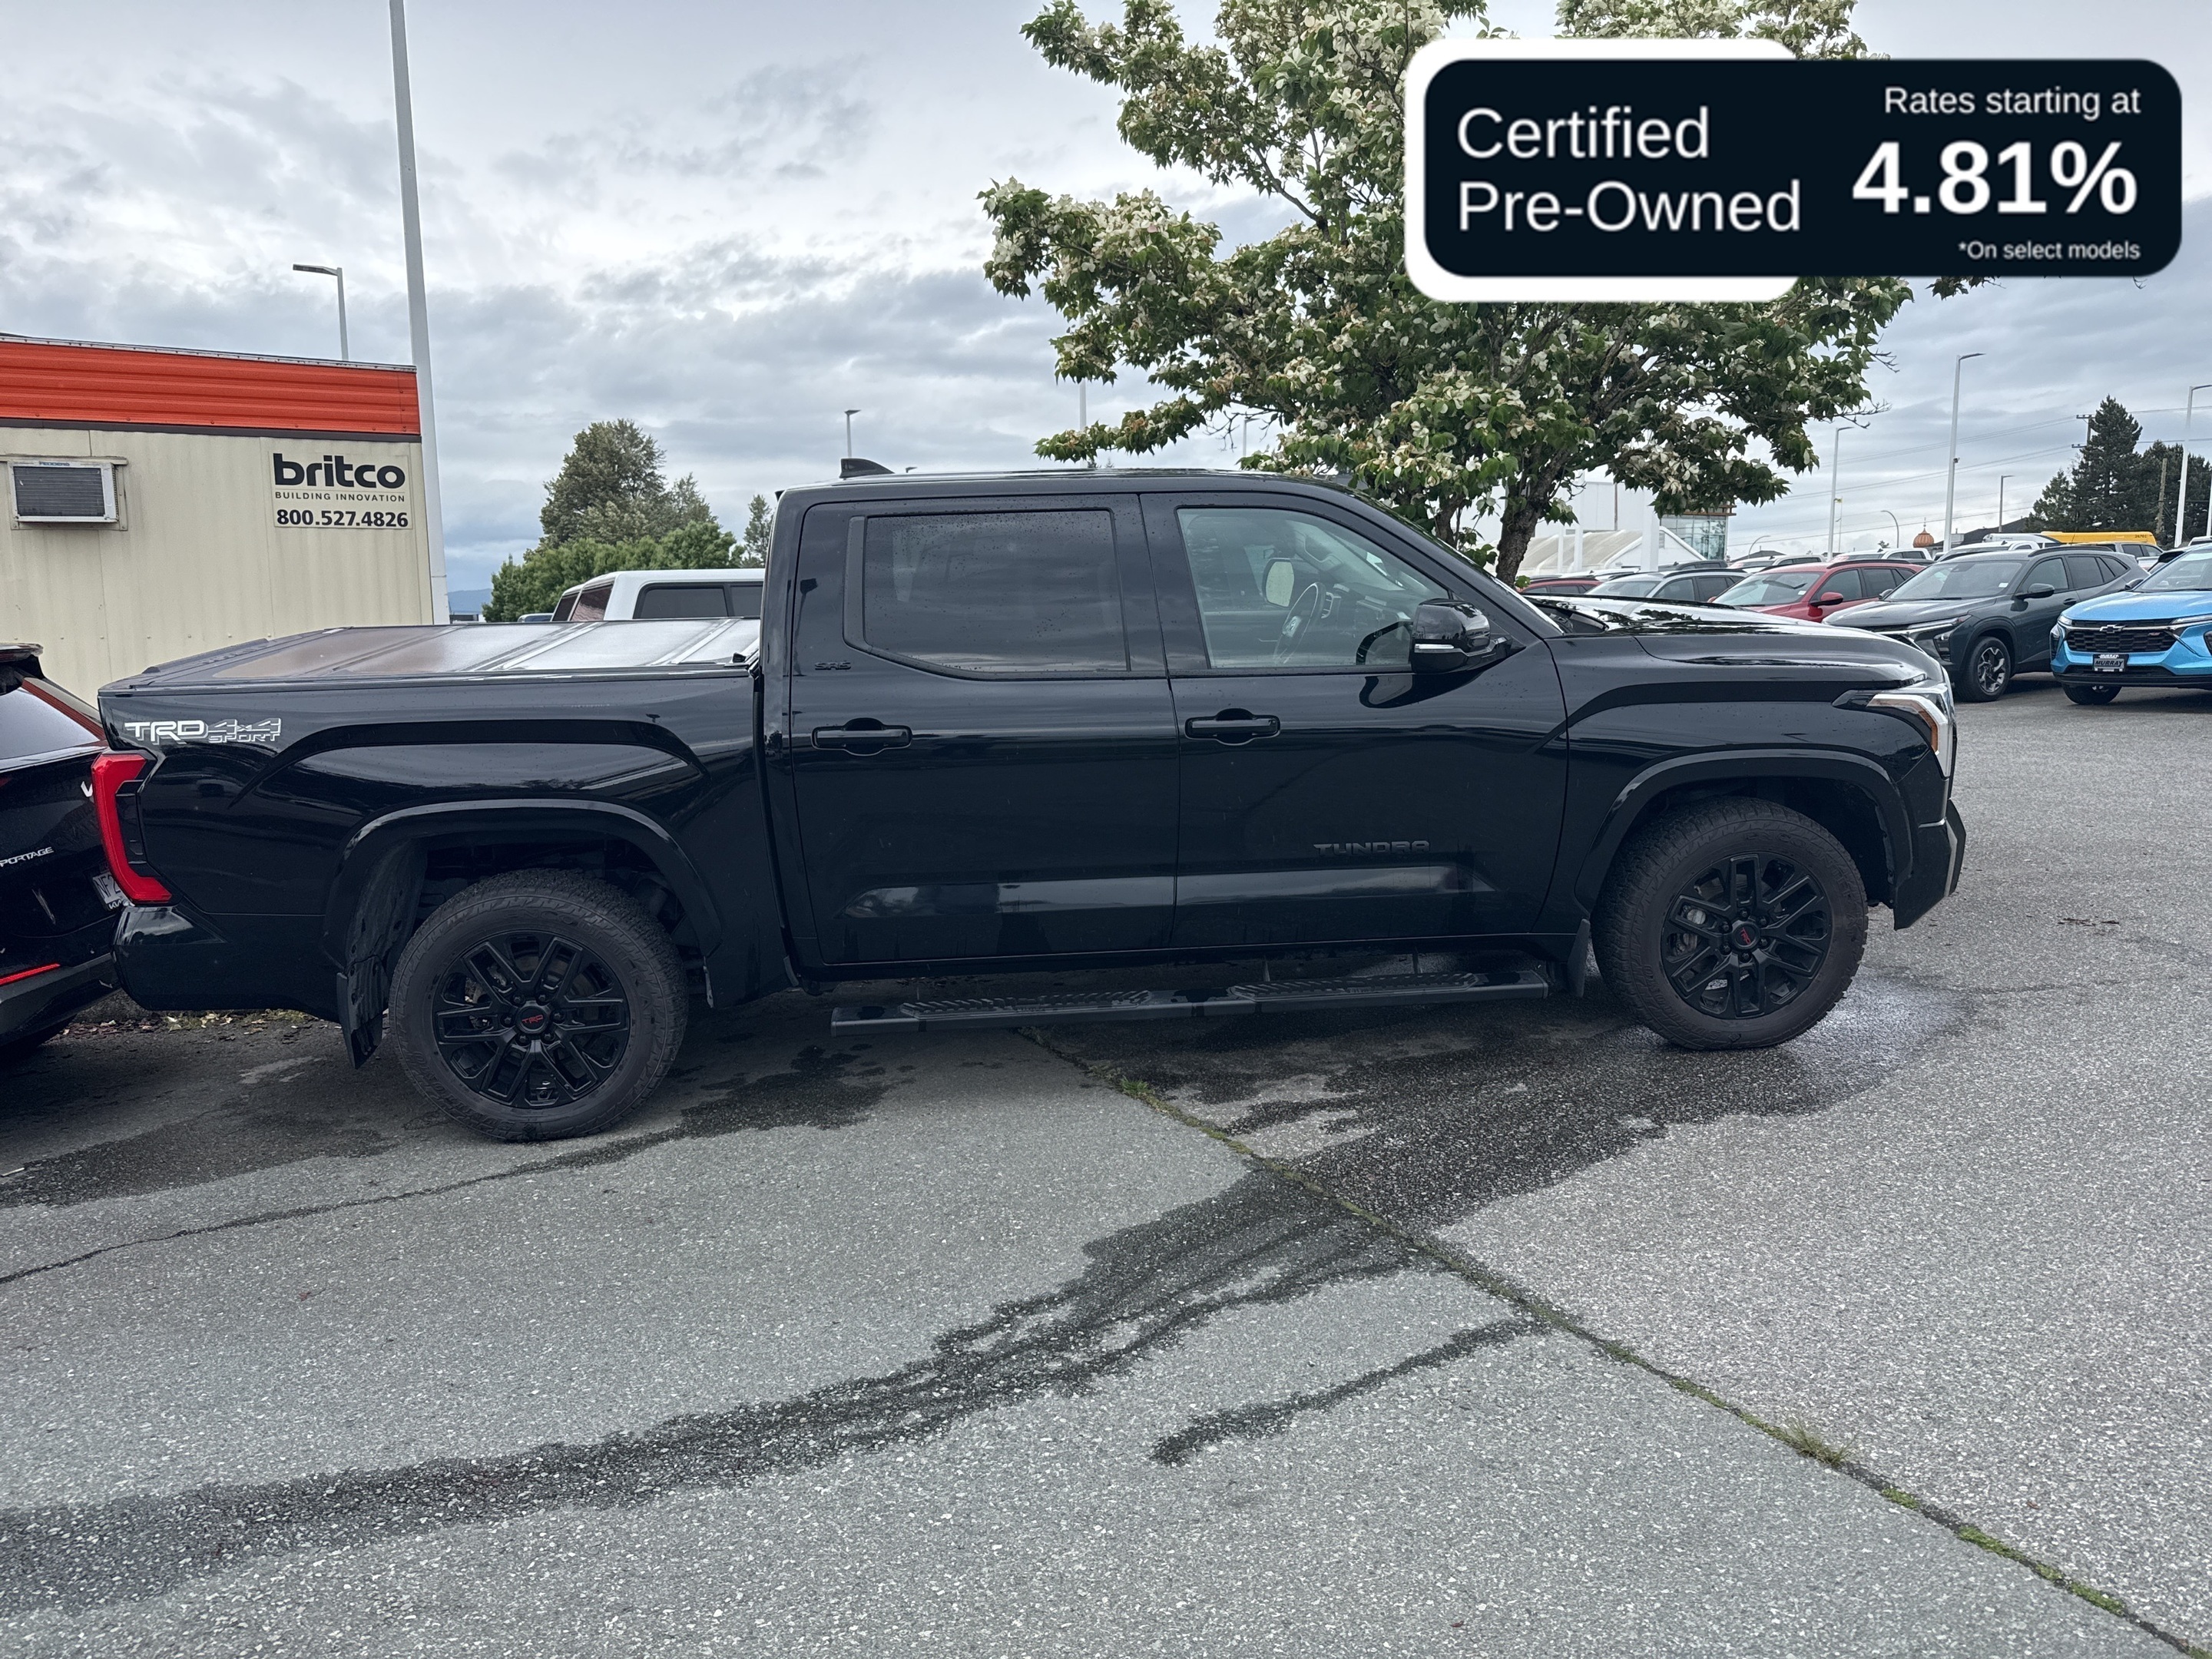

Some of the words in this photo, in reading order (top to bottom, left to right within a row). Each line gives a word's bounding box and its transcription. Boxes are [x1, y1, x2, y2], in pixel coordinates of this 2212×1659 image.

[273, 453, 406, 489] britco
[275, 492, 331, 500] BUILDING
[336, 493, 406, 502] INNOVATION
[276, 508, 409, 528] 800.527.4826
[124, 720, 209, 745] TRD
[208, 717, 281, 735] 4x4
[208, 732, 280, 743] SPORT
[1313, 840, 1430, 856] TUNDRA
[1740, 926, 1751, 945] TRD
[522, 1014, 544, 1024] TRD
